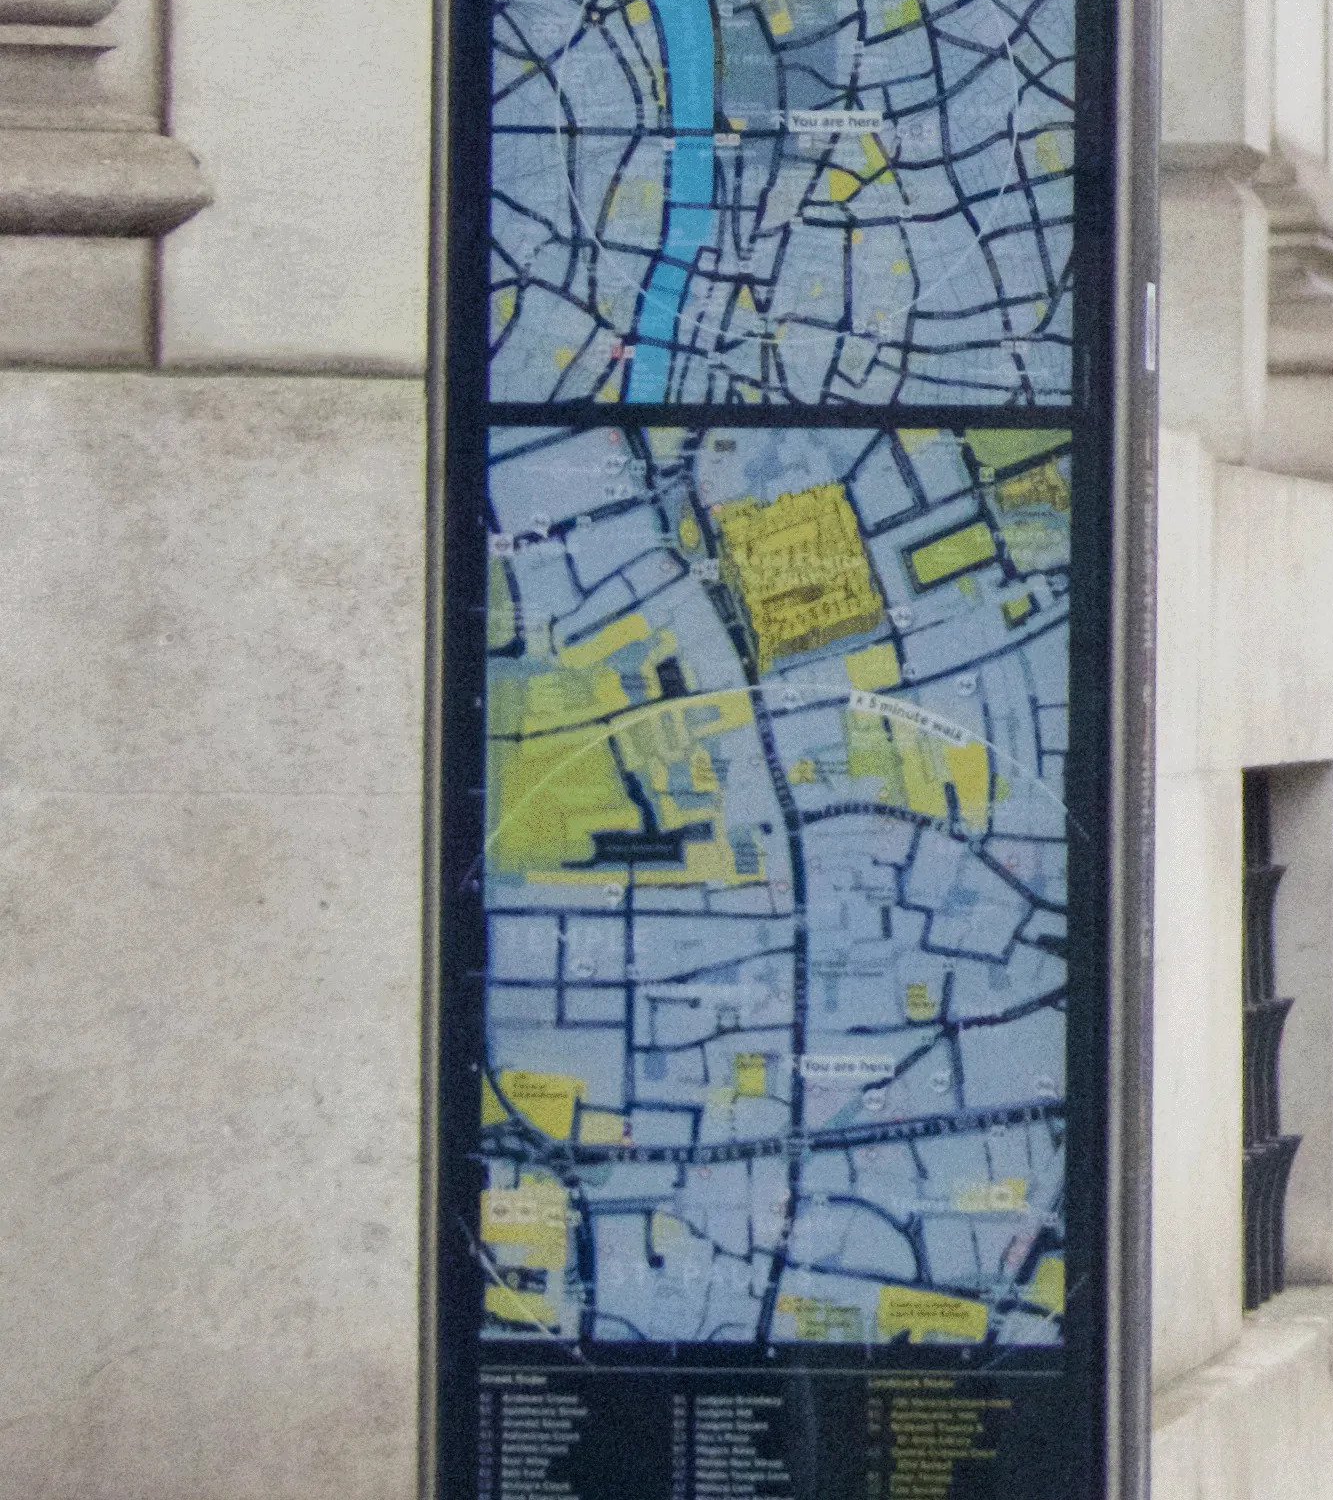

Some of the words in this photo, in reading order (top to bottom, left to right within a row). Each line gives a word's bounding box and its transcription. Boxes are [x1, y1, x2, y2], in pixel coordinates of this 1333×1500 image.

[791, 115, 817, 128] You
[821, 117, 844, 127] are
[848, 115, 880, 128] here
